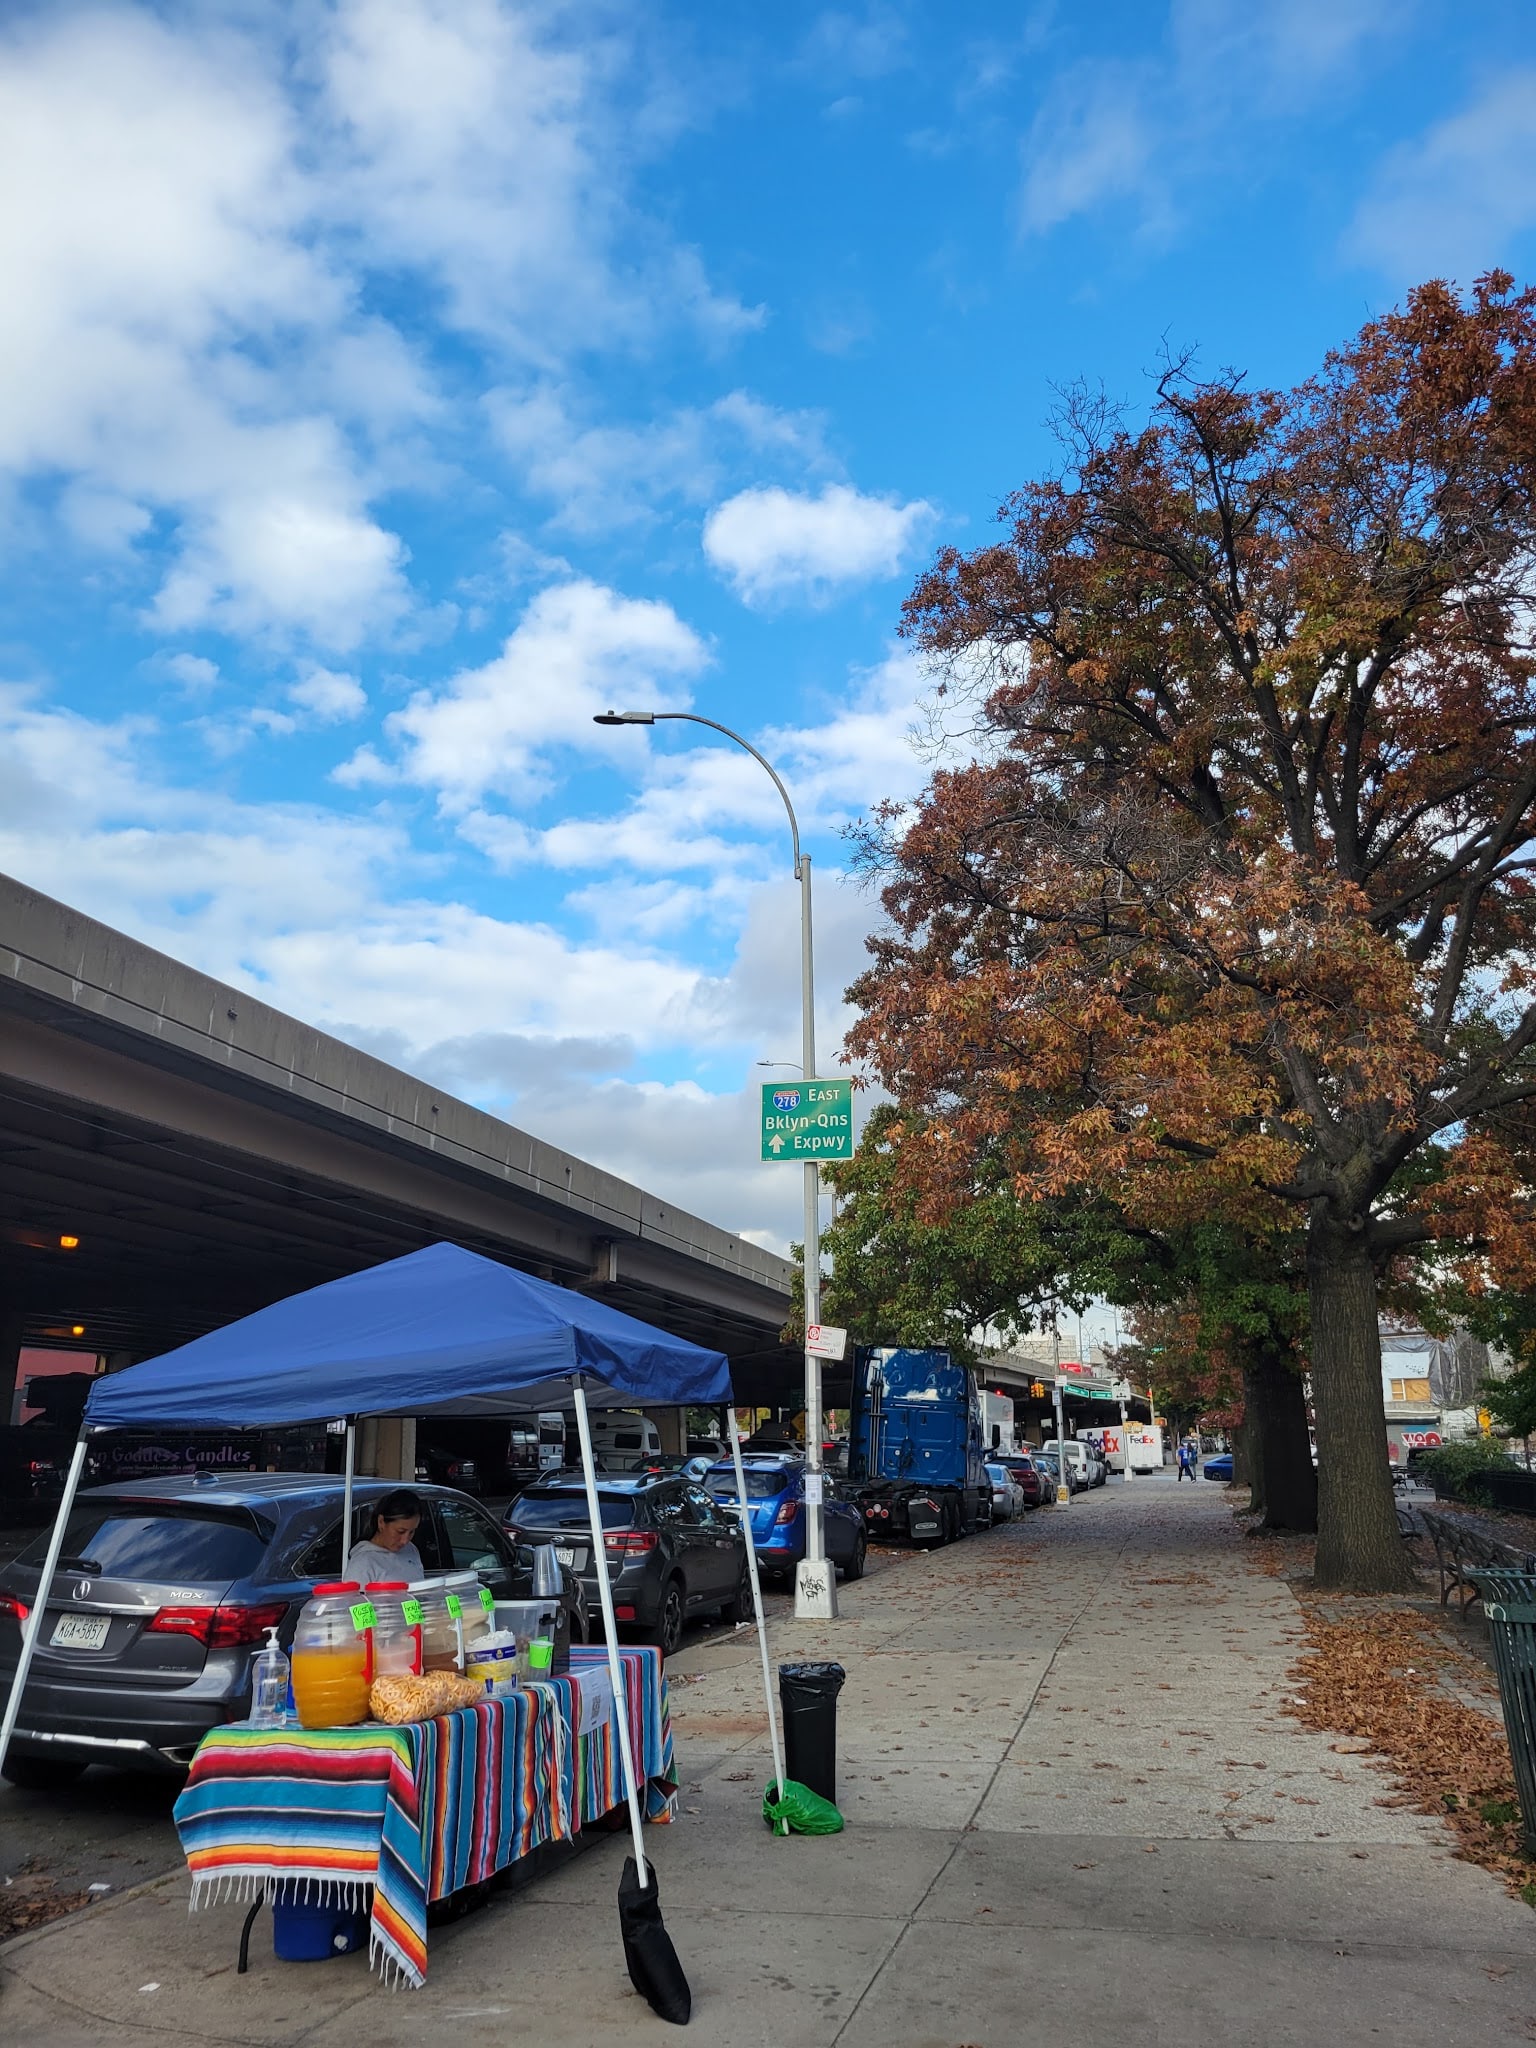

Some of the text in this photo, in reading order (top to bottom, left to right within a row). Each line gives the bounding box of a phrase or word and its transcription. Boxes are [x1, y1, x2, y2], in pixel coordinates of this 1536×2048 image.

[778, 1096, 797, 1108] 278
[765, 1114, 848, 1132] Bklyn-Qns
[794, 1135, 845, 1151] Expwy
[1129, 1435, 1155, 1444] FedEx
[112, 1446, 180, 1463] Goddess
[185, 1445, 251, 1465] Candles
[170, 1591, 204, 1600] MDX
[79, 1623, 105, 1641] 5857
